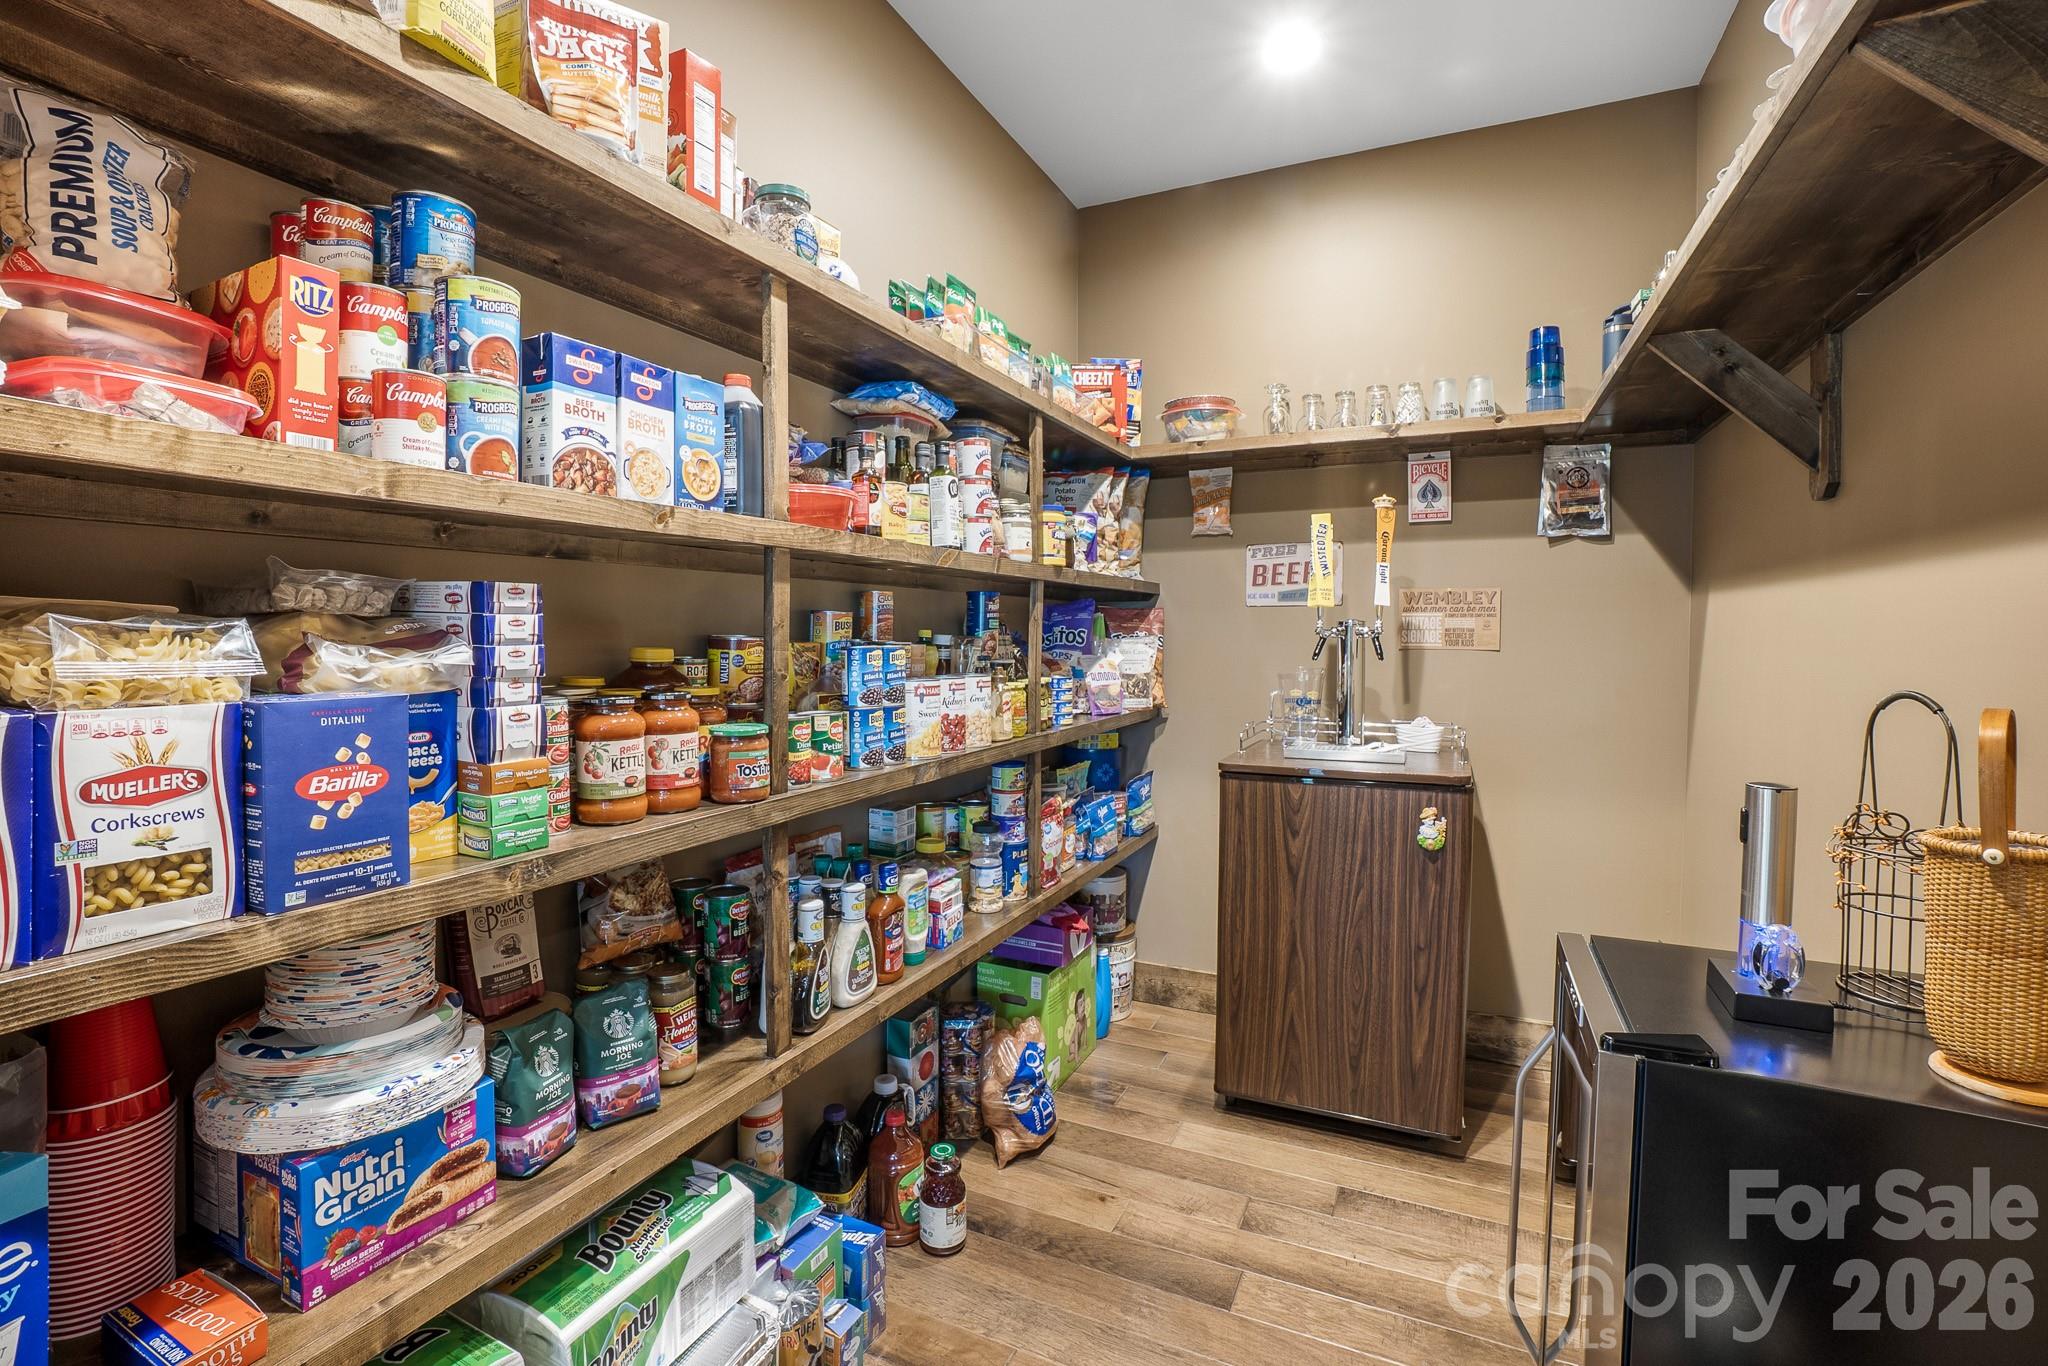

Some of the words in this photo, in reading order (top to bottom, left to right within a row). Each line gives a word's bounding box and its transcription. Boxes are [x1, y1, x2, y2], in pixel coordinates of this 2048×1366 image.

[439, 1, 464, 25] CORN
[466, 22, 489, 45] MEAL
[538, 31, 628, 75] JACK
[48, 107, 98, 266] PREMIUM
[109, 195, 135, 210] &
[111, 207, 139, 254] SOUP
[313, 206, 373, 238] Campbell's
[319, 252, 343, 264] Cream
[350, 251, 372, 262] Chicken
[290, 275, 334, 313] RITZ
[568, 357, 602, 372] SWANSON
[633, 374, 662, 389] SWANSON
[1073, 371, 1114, 386] CHEEZ-IT
[575, 398, 595, 408] BEEF
[564, 404, 605, 423] BROTH
[629, 410, 664, 424] CHICKEN
[687, 414, 714, 426] CHICKEN
[627, 417, 666, 437] BROTH
[684, 418, 717, 436] BROTH
[1412, 462, 1448, 481] BICYCLE
[1055, 487, 1076, 496] Potato
[1056, 495, 1074, 503] Chips
[1317, 523, 1328, 539] TEA
[1251, 544, 1298, 560] FREE
[1381, 531, 1391, 563] Corona
[1317, 540, 1332, 577] TWISTED
[1380, 564, 1389, 584] Light
[1259, 592, 1276, 600] COLD
[1402, 591, 1498, 606] WEMBLEY
[1402, 604, 1429, 613] where
[1429, 605, 1448, 613] men
[1449, 605, 1465, 613] can
[1466, 604, 1477, 613] be
[1477, 605, 1496, 613] men
[1402, 616, 1441, 630] VINTAGE
[1401, 630, 1441, 644] SIGNAGE
[1460, 640, 1475, 648] KIDS
[719, 657, 731, 685] VALUE
[72, 723, 88, 732] 200
[320, 715, 366, 726] DITALINI
[411, 734, 428, 742] Kraft
[429, 743, 440, 755] &
[673, 748, 699, 765] KETTL
[408, 755, 443, 768] eese
[611, 754, 644, 773] KETTLE
[515, 769, 533, 779] Whole
[533, 766, 548, 776] Grain
[91, 771, 199, 802] MUELLER'S
[308, 772, 379, 795] Barilla
[521, 794, 542, 805] Veggie
[91, 808, 205, 833] Corkscrews
[322, 844, 343, 853] SELECTED
[343, 841, 363, 849] PREMIUM
[56, 852, 98, 862] VERIFIED
[319, 872, 349, 882] PERFECTION
[354, 865, 374, 876] 10-11
[474, 894, 535, 939] BOXCAR
[533, 963, 539, 980] 3
[600, 1040, 644, 1058] MORNING
[616, 1051, 632, 1062] JOE
[535, 1074, 571, 1101] MORNING
[548, 1088, 562, 1101] JOE
[1031, 1105, 1042, 1132] JUMBO
[450, 1140, 460, 1149] NO
[254, 1157, 280, 1177] TOASTE
[314, 1137, 404, 1210] Nutri
[315, 1167, 405, 1227] Grain
[574, 1188, 674, 1275] Bounty
[630, 1215, 664, 1252] Napkins
[635, 1216, 674, 1263] Serviettes
[330, 1256, 358, 1276] MIXED
[358, 1240, 385, 1259] BERRY
[505, 1264, 537, 1286] 200
[161, 1280, 221, 1306] PICKS
[312, 1285, 324, 1299] 8
[308, 1294, 327, 1308] bars
[119, 1305, 144, 1328] Forster
[166, 1304, 237, 1337] TOOTH
[590, 1295, 659, 1366] ounty
[795, 1318, 817, 1340] TUFF
[149, 1337, 175, 1357] ROUND
[170, 1346, 187, 1363] 800
